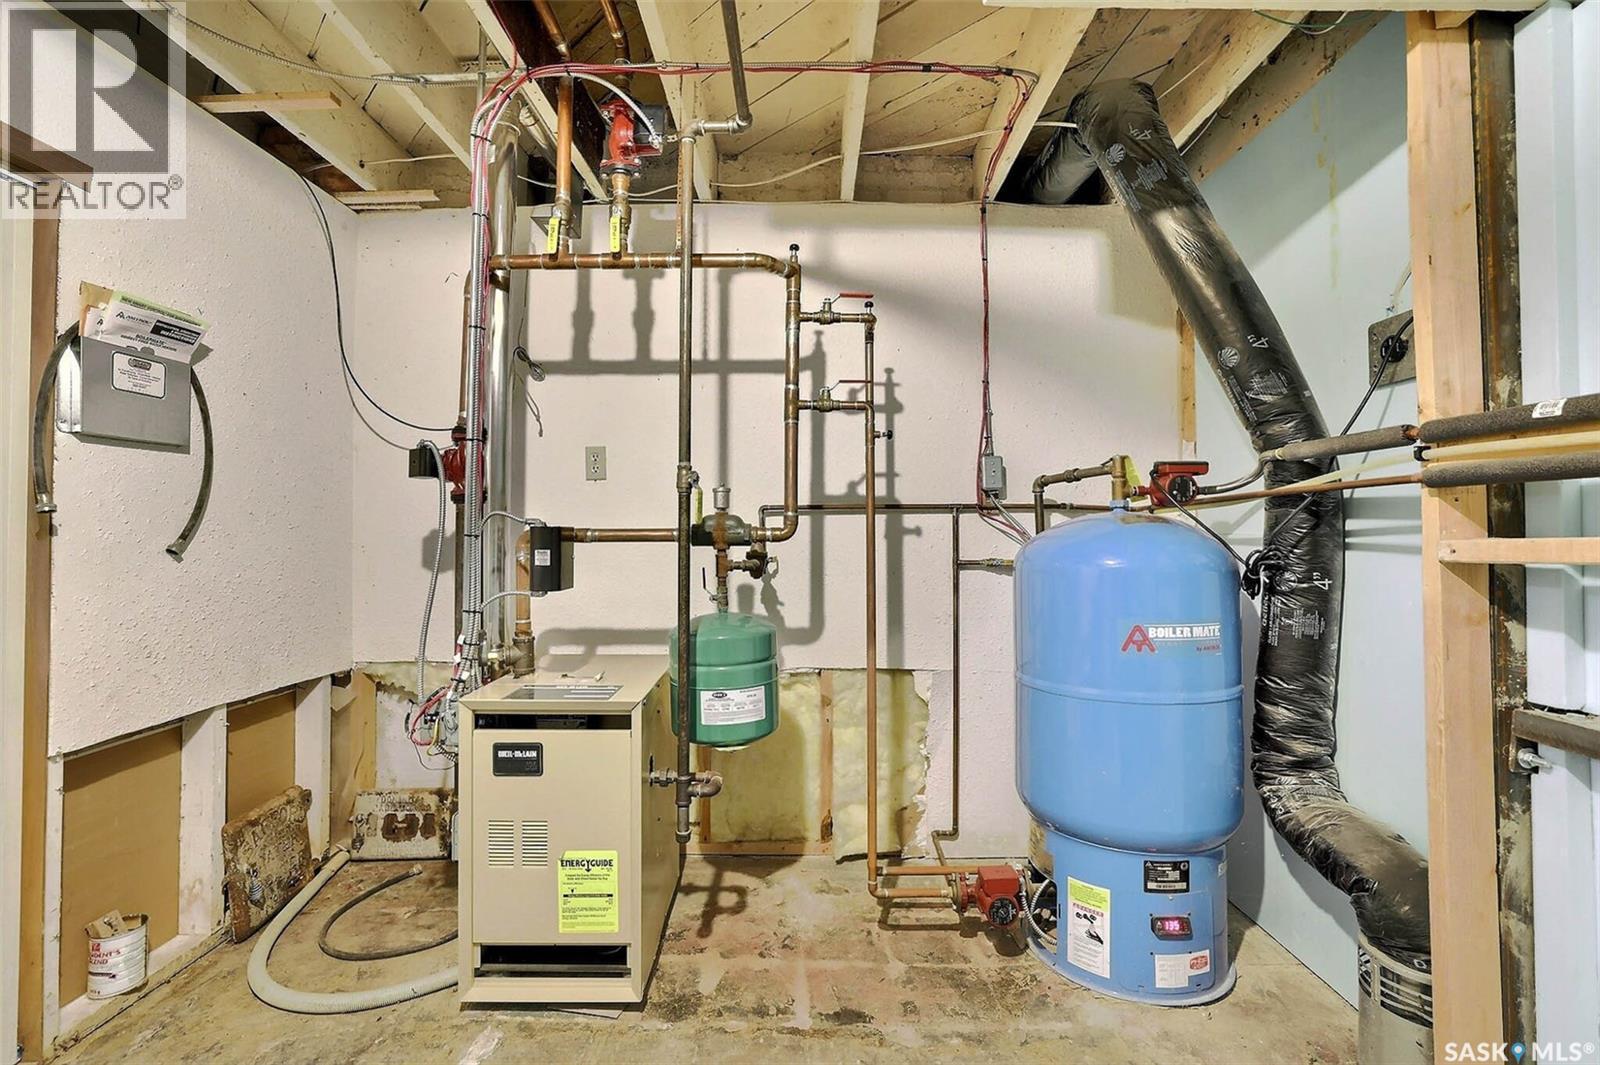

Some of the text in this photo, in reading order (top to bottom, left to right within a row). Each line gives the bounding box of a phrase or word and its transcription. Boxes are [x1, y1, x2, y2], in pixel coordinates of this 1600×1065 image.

[1148, 625, 1221, 639] BOILER MATE
[560, 859, 614, 871] ENERGYGUIDE
